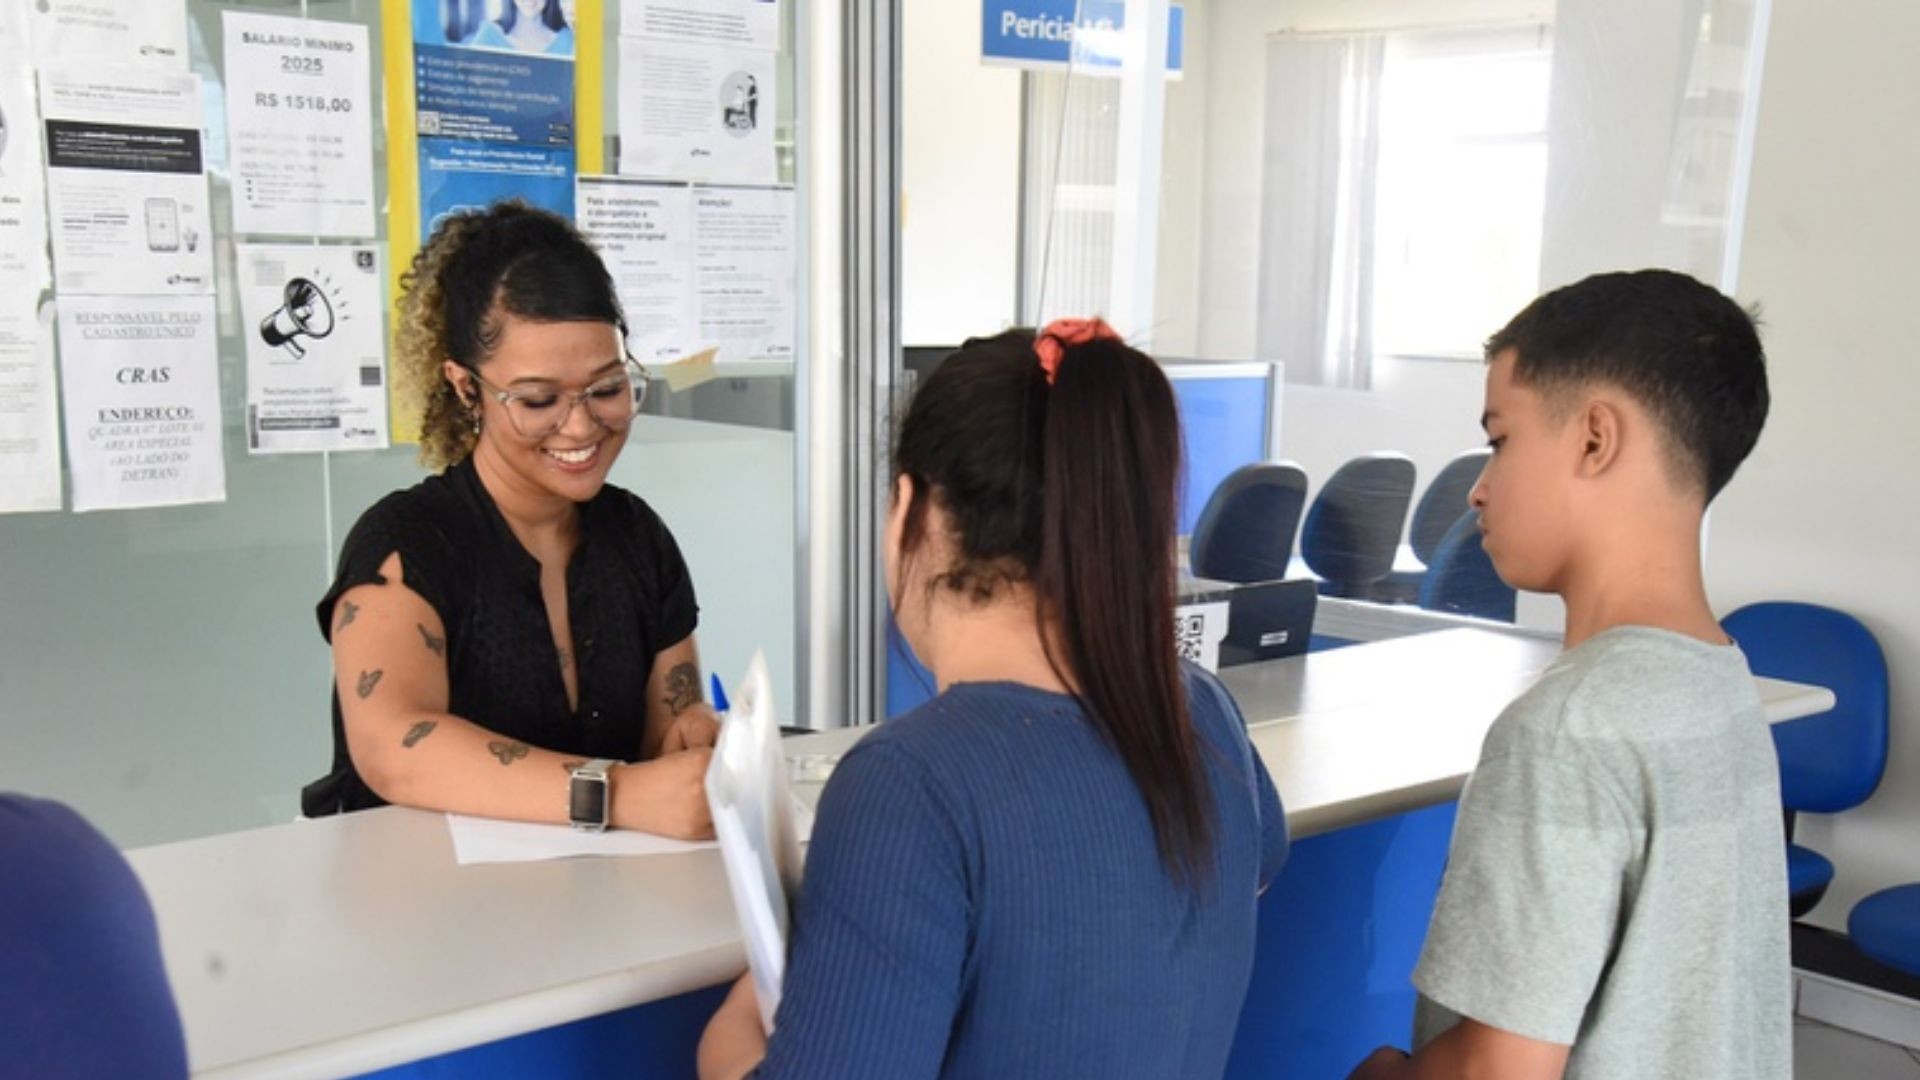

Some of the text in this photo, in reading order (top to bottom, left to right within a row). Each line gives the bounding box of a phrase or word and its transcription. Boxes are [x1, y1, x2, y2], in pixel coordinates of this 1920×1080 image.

[281, 55, 324, 75] 2025
[285, 94, 352, 113] 1518,00
[116, 366, 171, 384] CRAS
[98, 407, 194, 423] ENDEREÇO:
[136, 436, 192, 450] ESPECIAL
[135, 452, 169, 465] LADO
[169, 450, 191, 463] DO
